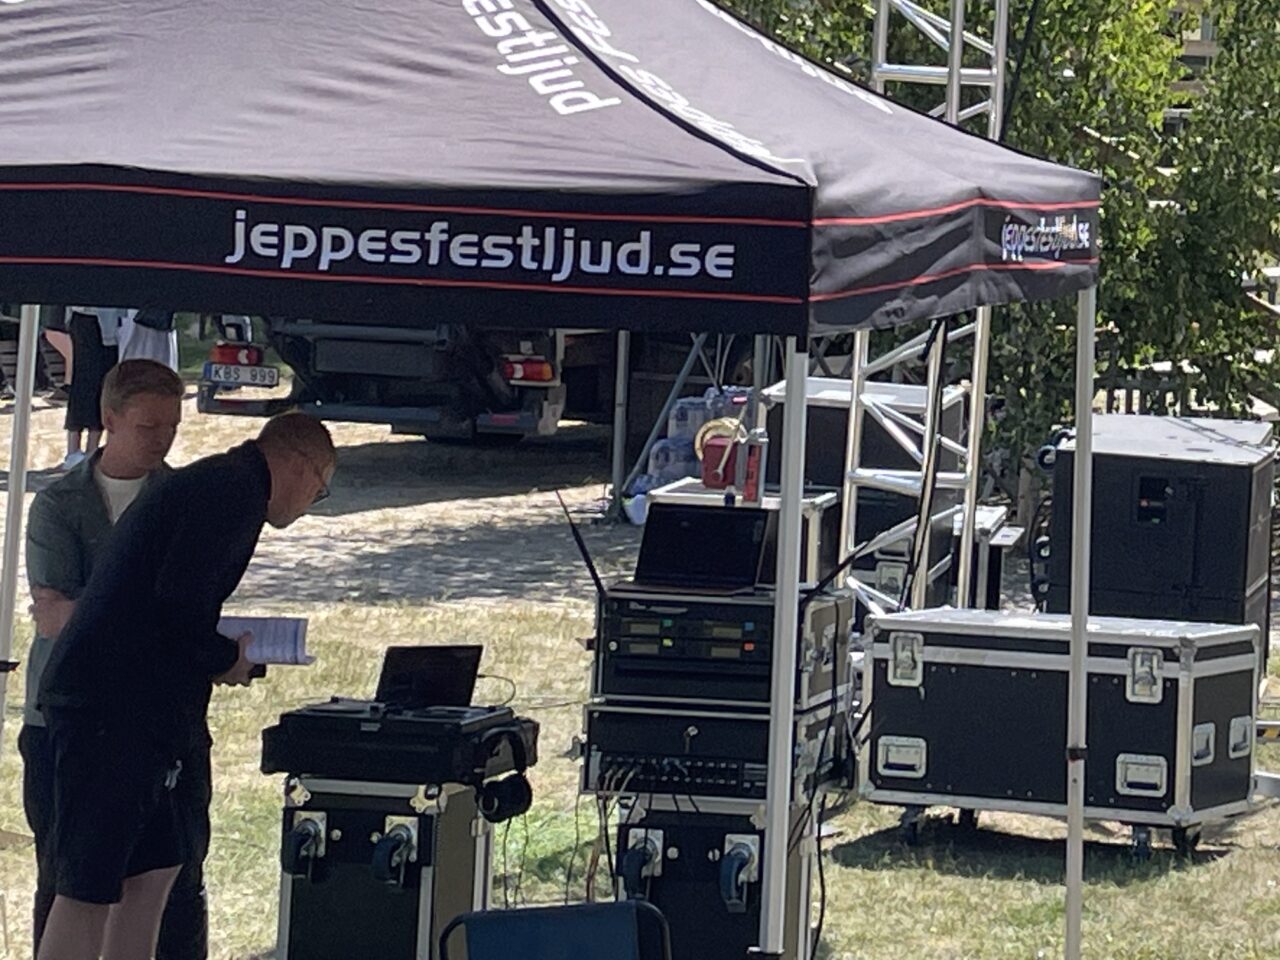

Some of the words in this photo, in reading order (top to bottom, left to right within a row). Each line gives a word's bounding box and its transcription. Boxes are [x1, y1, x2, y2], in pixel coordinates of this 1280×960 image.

[225, 209, 736, 282] jeppesfestljud.se
[213, 364, 241, 381] KBS
[249, 367, 276, 384] 999
